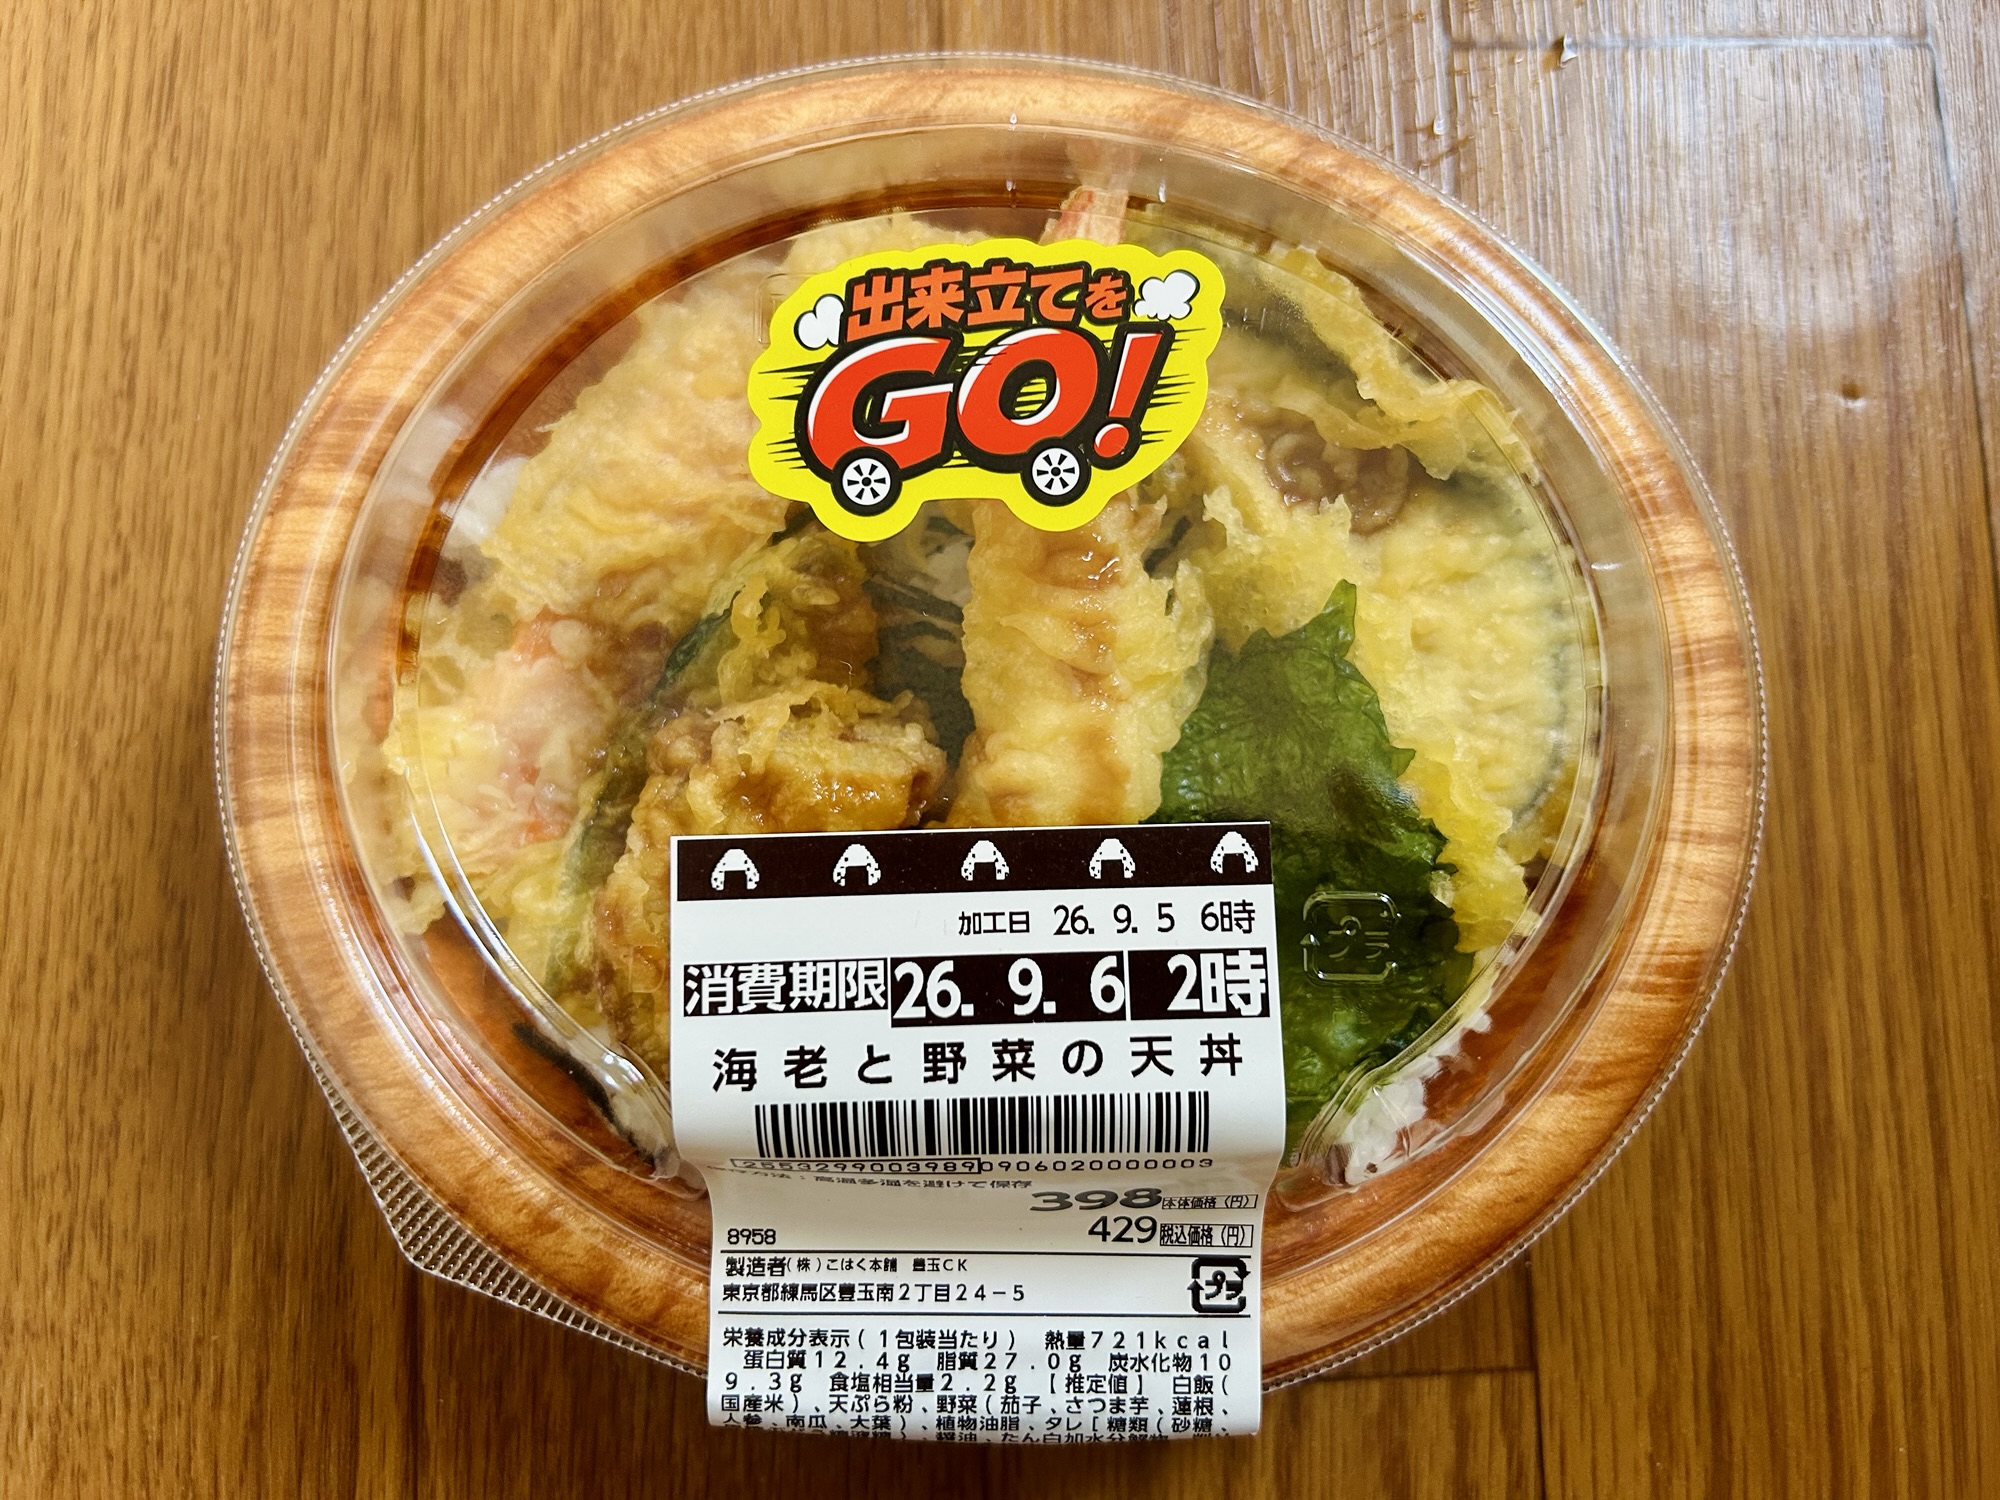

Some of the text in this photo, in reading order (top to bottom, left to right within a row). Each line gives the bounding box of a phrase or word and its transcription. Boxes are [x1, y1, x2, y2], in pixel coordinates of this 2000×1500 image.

[843, 259, 1130, 343] 出来立てを
[801, 323, 1169, 476] GO!
[958, 910, 1031, 936] 加工日
[1200, 899, 1256, 934] 6時
[684, 959, 887, 1016] 消費期限
[1166, 949, 1268, 1017] 2時
[711, 1032, 1243, 1093] 海老と野菜の天丼
[1029, 1187, 1163, 1212] 398
[727, 1228, 777, 1245] 8958
[1087, 1215, 1158, 1244] 429
